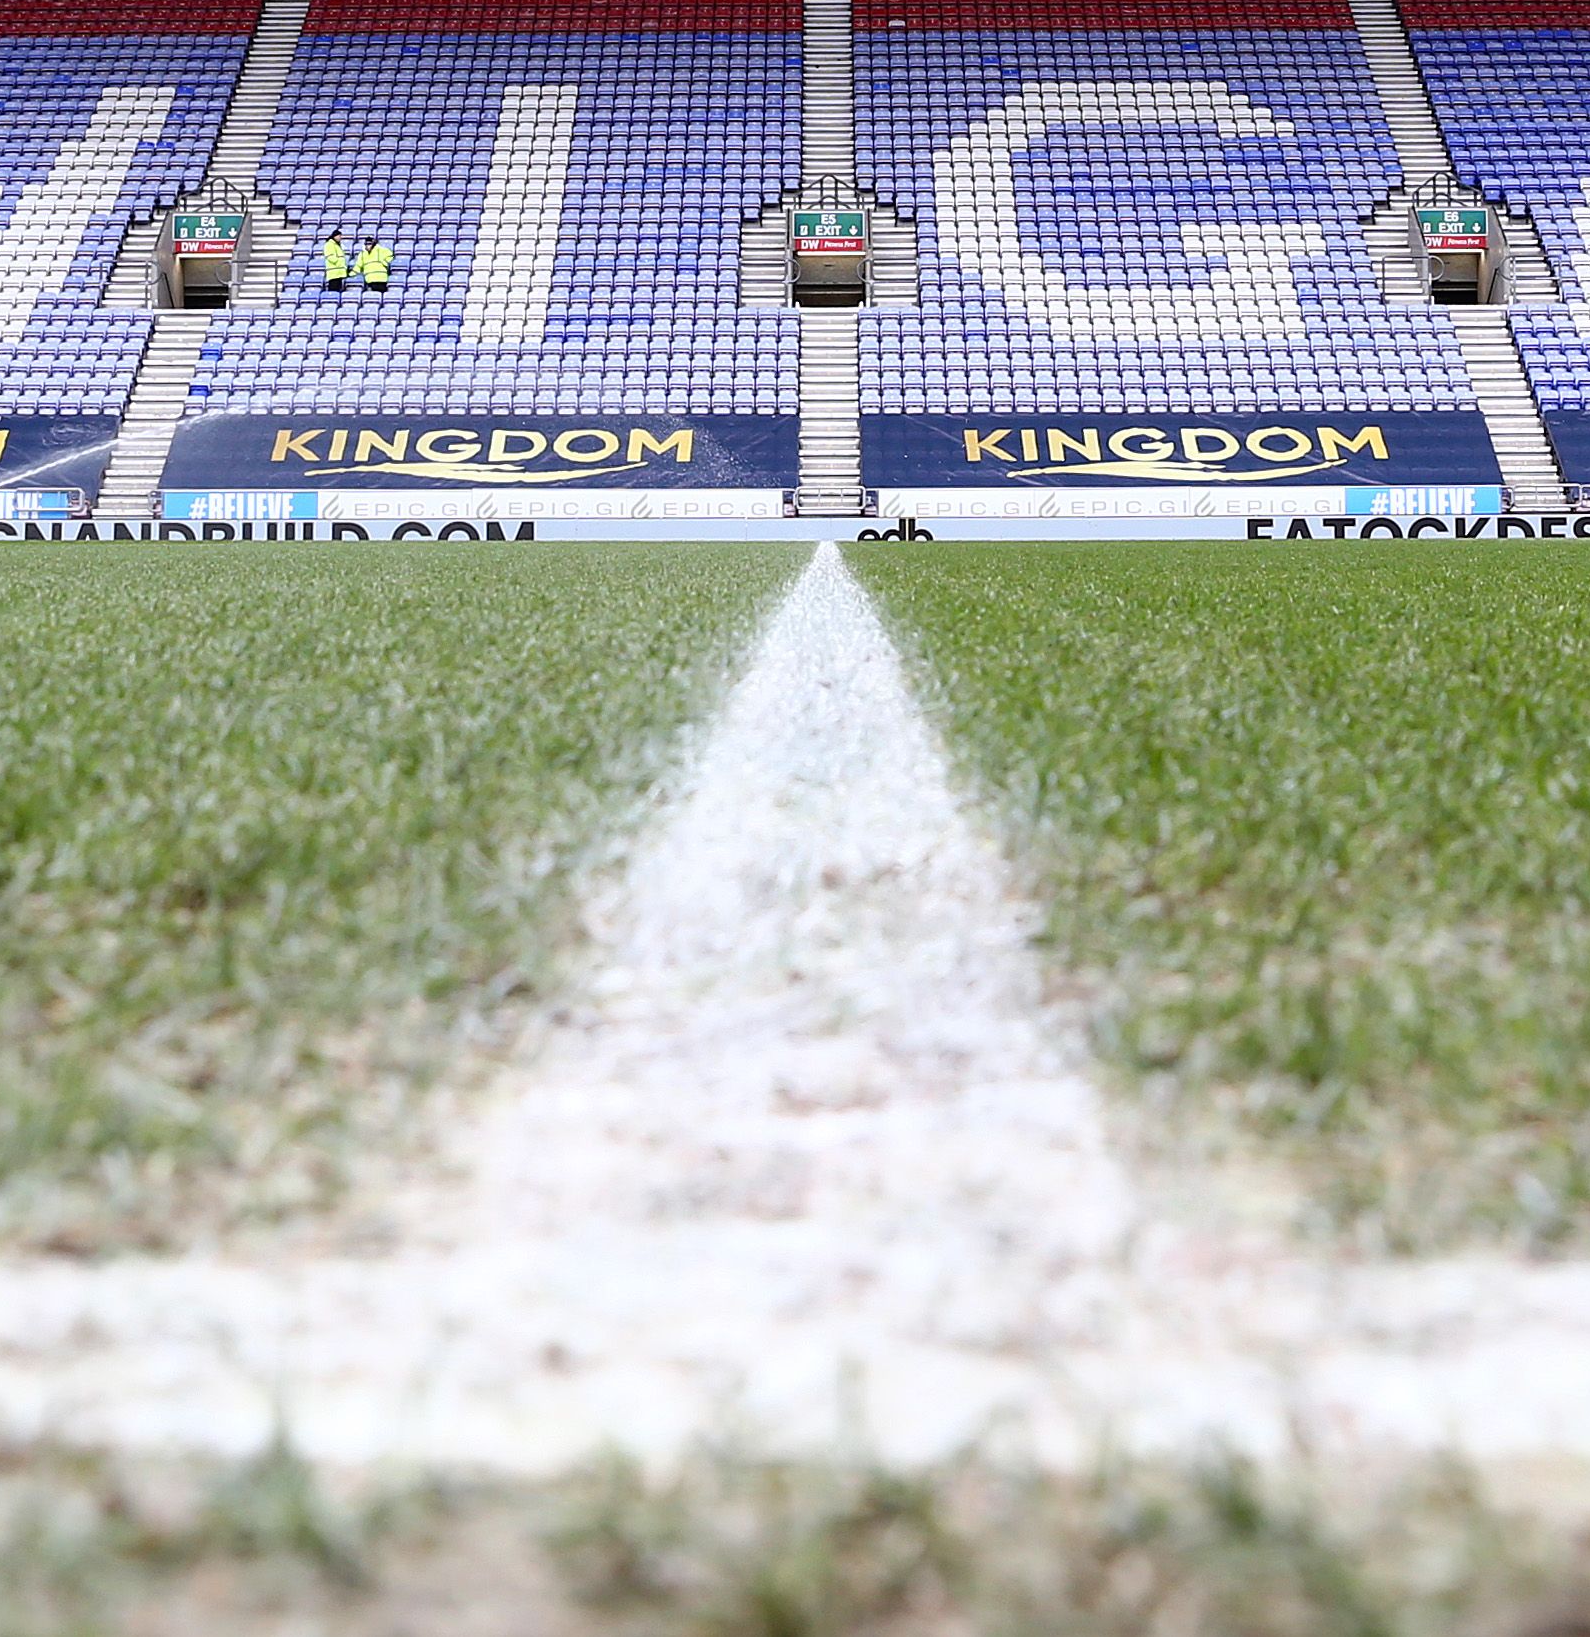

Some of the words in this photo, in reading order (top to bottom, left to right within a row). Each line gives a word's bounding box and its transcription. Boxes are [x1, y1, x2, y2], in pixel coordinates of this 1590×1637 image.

[195, 227, 221, 238] EXIT
[815, 226, 842, 236] EXIT
[1438, 223, 1465, 233] EXIT
[181, 242, 199, 252] DW
[801, 239, 819, 249] DW
[270, 428, 694, 463] KINGDOM
[963, 426, 1389, 462] KINGDOM
